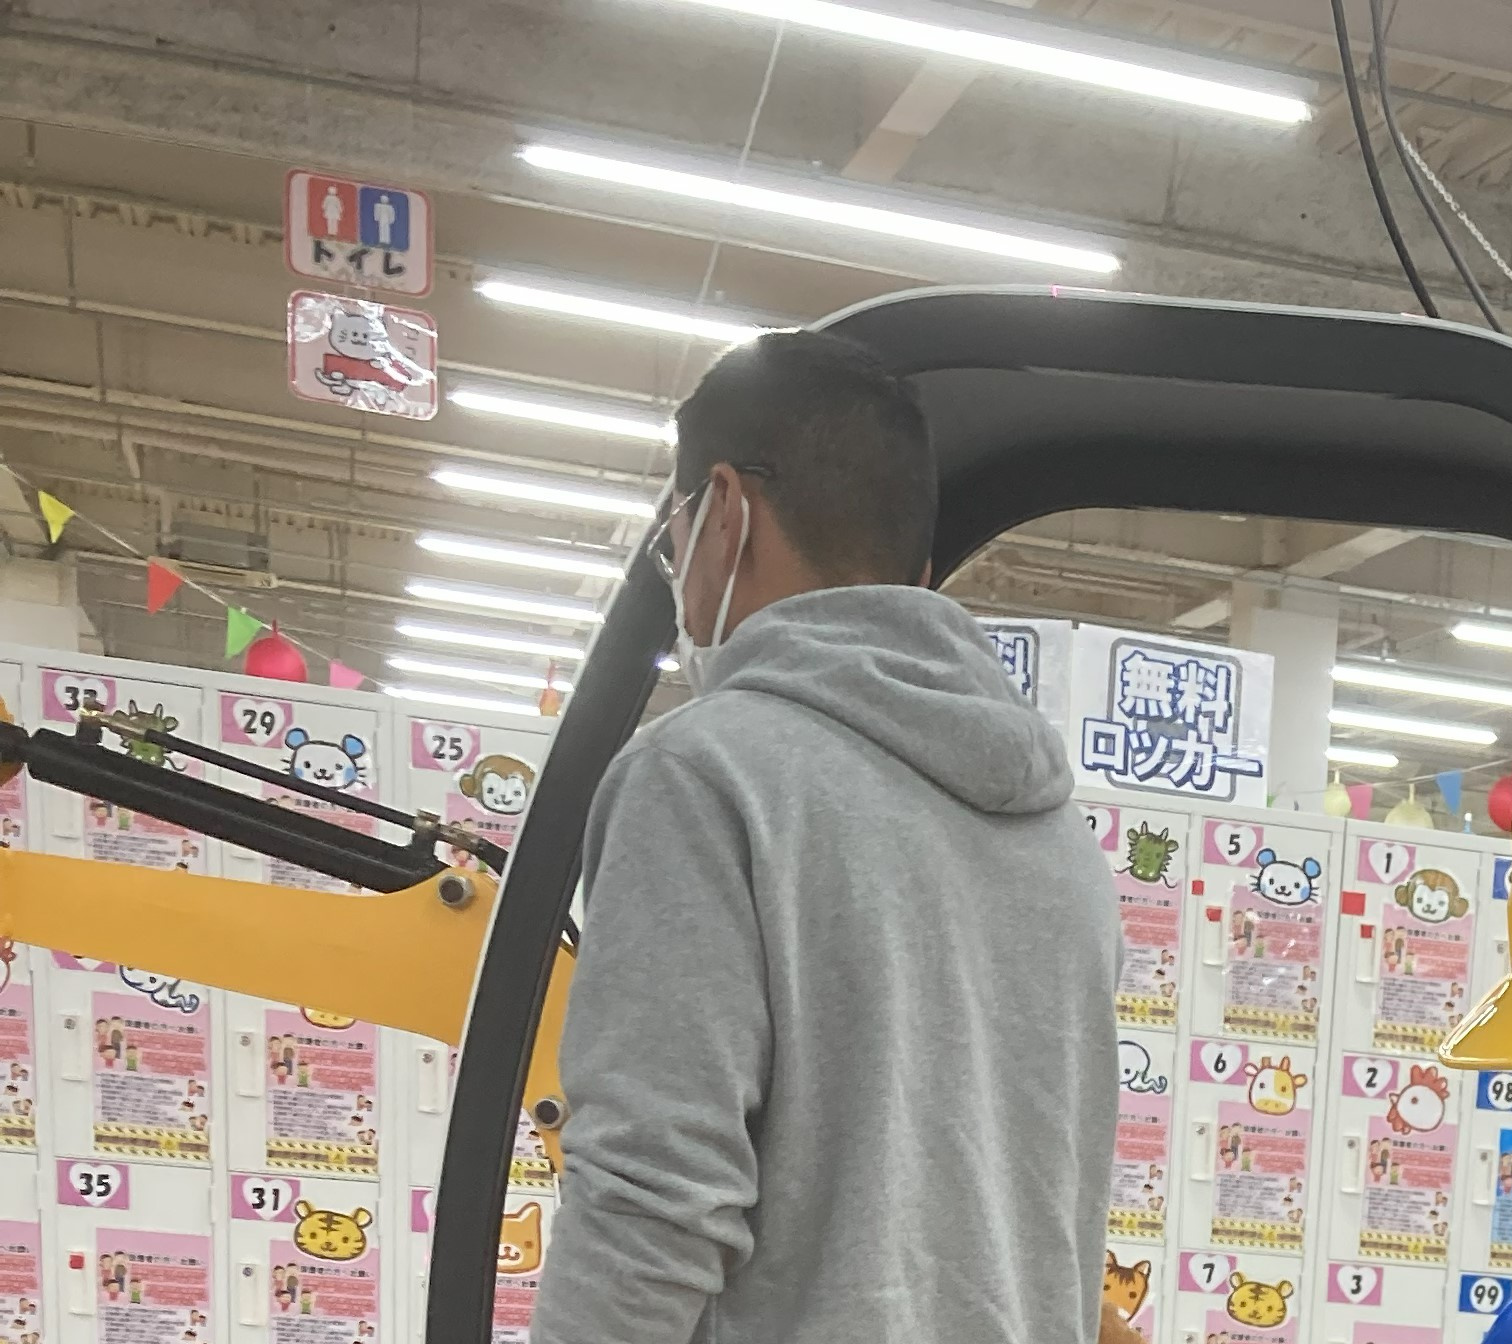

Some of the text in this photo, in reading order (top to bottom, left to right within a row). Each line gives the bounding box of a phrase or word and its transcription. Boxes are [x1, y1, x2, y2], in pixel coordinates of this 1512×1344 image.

[312, 239, 406, 276] トイレ
[1118, 650, 1232, 733] 無料
[242, 709, 275, 736] 29
[431, 735, 464, 761] 25
[1082, 717, 1263, 791] ロッカー
[1228, 833, 1241, 856] 5
[1384, 852, 1393, 874] 1
[1213, 1052, 1227, 1074] 6
[1365, 1067, 1378, 1088] 2
[79, 1172, 112, 1198] 35
[251, 1187, 280, 1211] 31
[1202, 1262, 1216, 1284] 7
[1350, 1274, 1363, 1295] 3
[1473, 1284, 1499, 1306] 99
